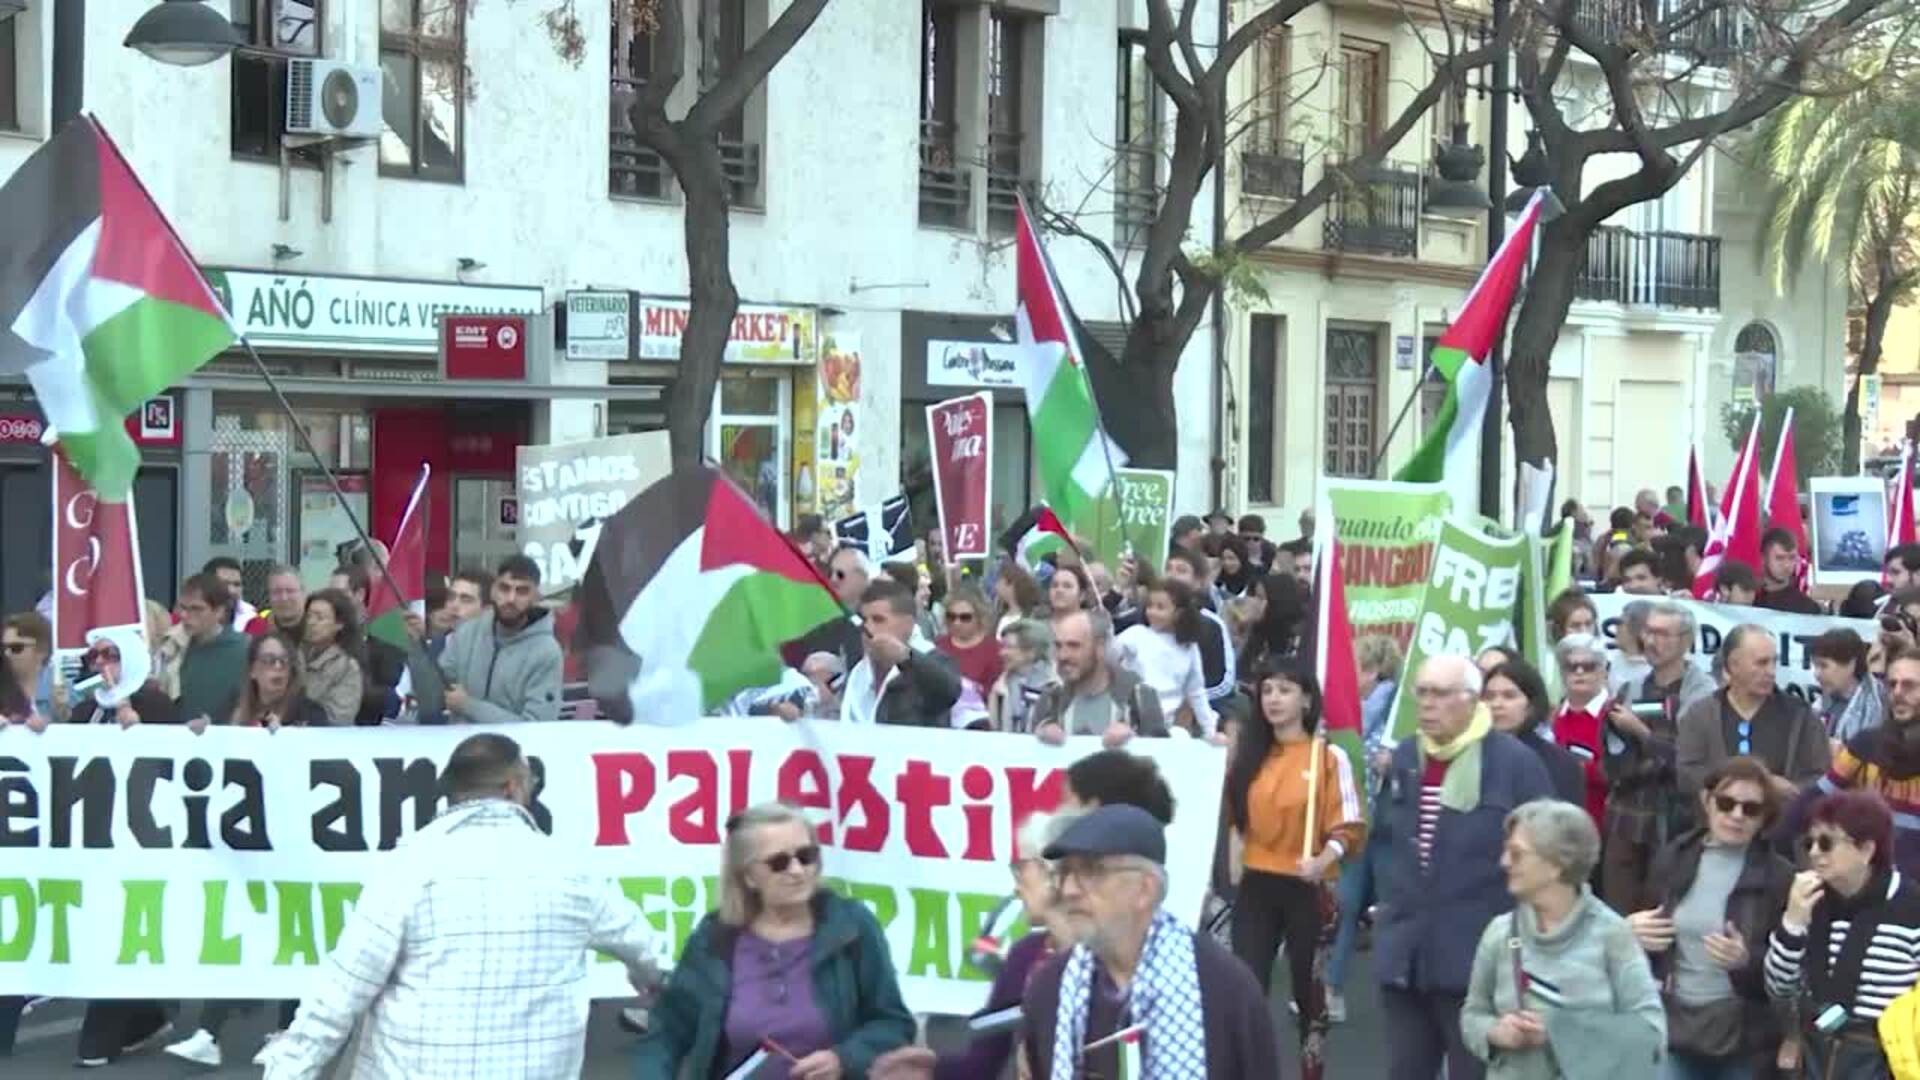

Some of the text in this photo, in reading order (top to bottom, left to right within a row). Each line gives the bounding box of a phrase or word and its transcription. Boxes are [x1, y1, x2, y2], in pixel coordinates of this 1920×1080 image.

[247, 278, 314, 328] AÑÓ
[329, 291, 411, 327] CLÍNICA
[645, 307, 789, 342] MIN RKET
[1335, 515, 1415, 541] uando
[589, 748, 1067, 865] Palestin
[116, 879, 168, 966] A
